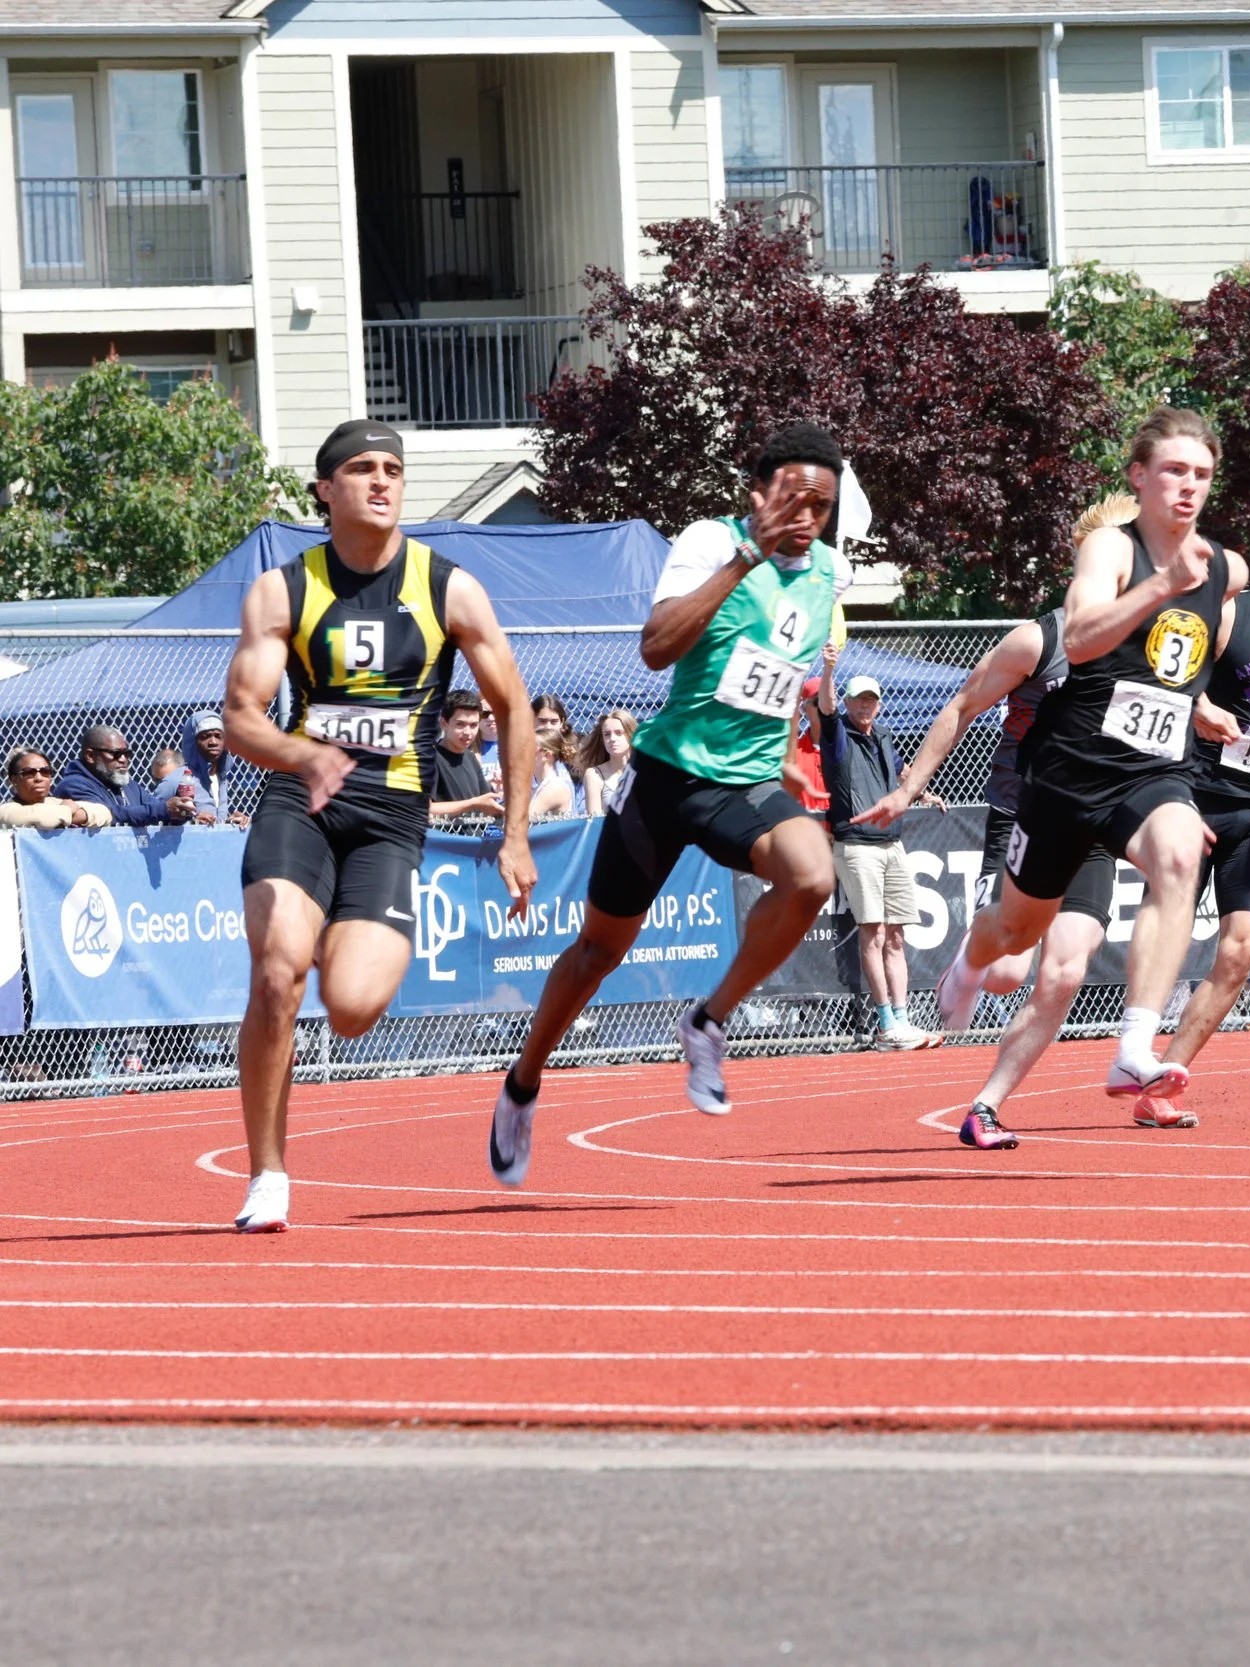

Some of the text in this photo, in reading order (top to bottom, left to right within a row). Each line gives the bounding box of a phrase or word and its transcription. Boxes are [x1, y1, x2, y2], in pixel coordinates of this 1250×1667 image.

[355, 625, 375, 668] 5
[780, 611, 797, 648] 4
[1163, 637, 1183, 678] 3
[742, 661, 795, 709] 514
[1122, 701, 1176, 744] 316
[1008, 828, 1022, 867] 3
[903, 850, 1146, 950] STE
[976, 878, 988, 911] 2
[126, 899, 248, 944] Gesa Cre
[484, 900, 548, 940] DAVIS
[554, 896, 586, 935] LA
[493, 955, 533, 974] SERIOUS
[632, 947, 664, 964] DEATH
[664, 943, 719, 962] ATTORNEYS
